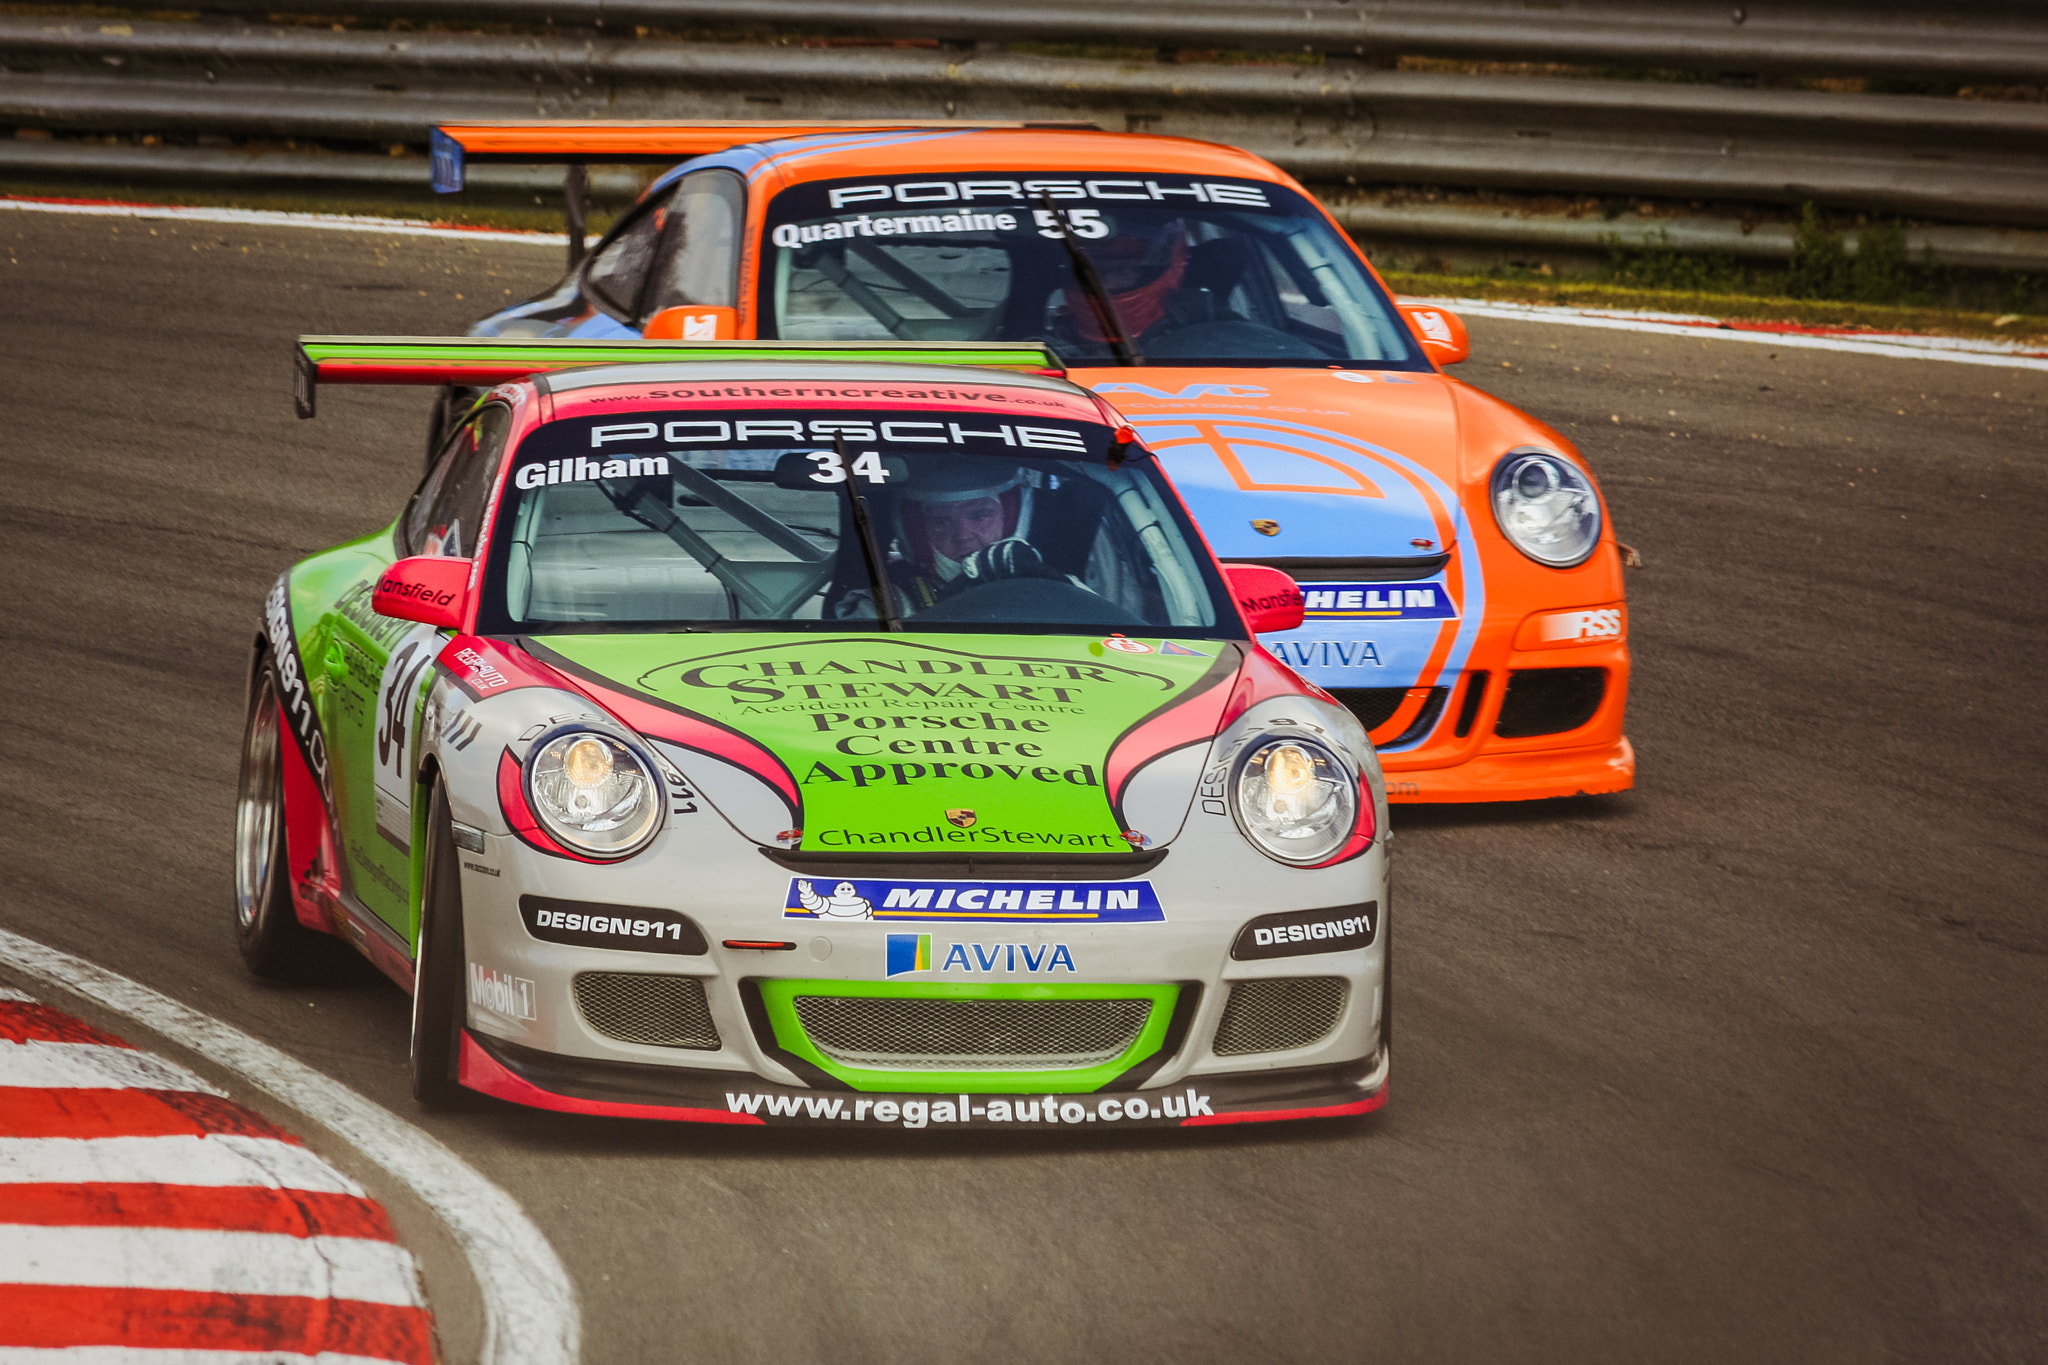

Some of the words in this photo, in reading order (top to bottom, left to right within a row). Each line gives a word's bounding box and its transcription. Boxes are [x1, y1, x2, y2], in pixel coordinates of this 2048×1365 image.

[829, 180, 1272, 208] PORSCHE
[772, 209, 1018, 249] Quartermaine
[1033, 209, 1110, 239] 55
[590, 386, 1067, 408] www.southerncreative.co.uk
[590, 420, 1088, 453] PORSCHE
[515, 455, 671, 490] Gilham
[806, 450, 891, 484] 34
[1301, 590, 1436, 608] HELIN
[1271, 640, 1385, 668] AVIVA
[681, 659, 1115, 689] CHANDLER
[730, 678, 1082, 705] STEWART
[378, 641, 432, 779] 34
[740, 700, 874, 716] Accident
[879, 698, 976, 711] Repair
[988, 699, 1086, 716] Centre
[808, 711, 1051, 733] Porsche
[835, 734, 1043, 758] Centre
[801, 760, 1101, 788] Approved
[817, 826, 1115, 850] ChandlerStewart
[882, 887, 1140, 911] MICHELIN
[535, 909, 683, 941] DESIGN911
[1252, 914, 1374, 946] DESIGN911
[939, 942, 1079, 974] AVIVA
[470, 962, 515, 1016] Mobil
[724, 1087, 1216, 1127] www.regal-auto.co.uk
